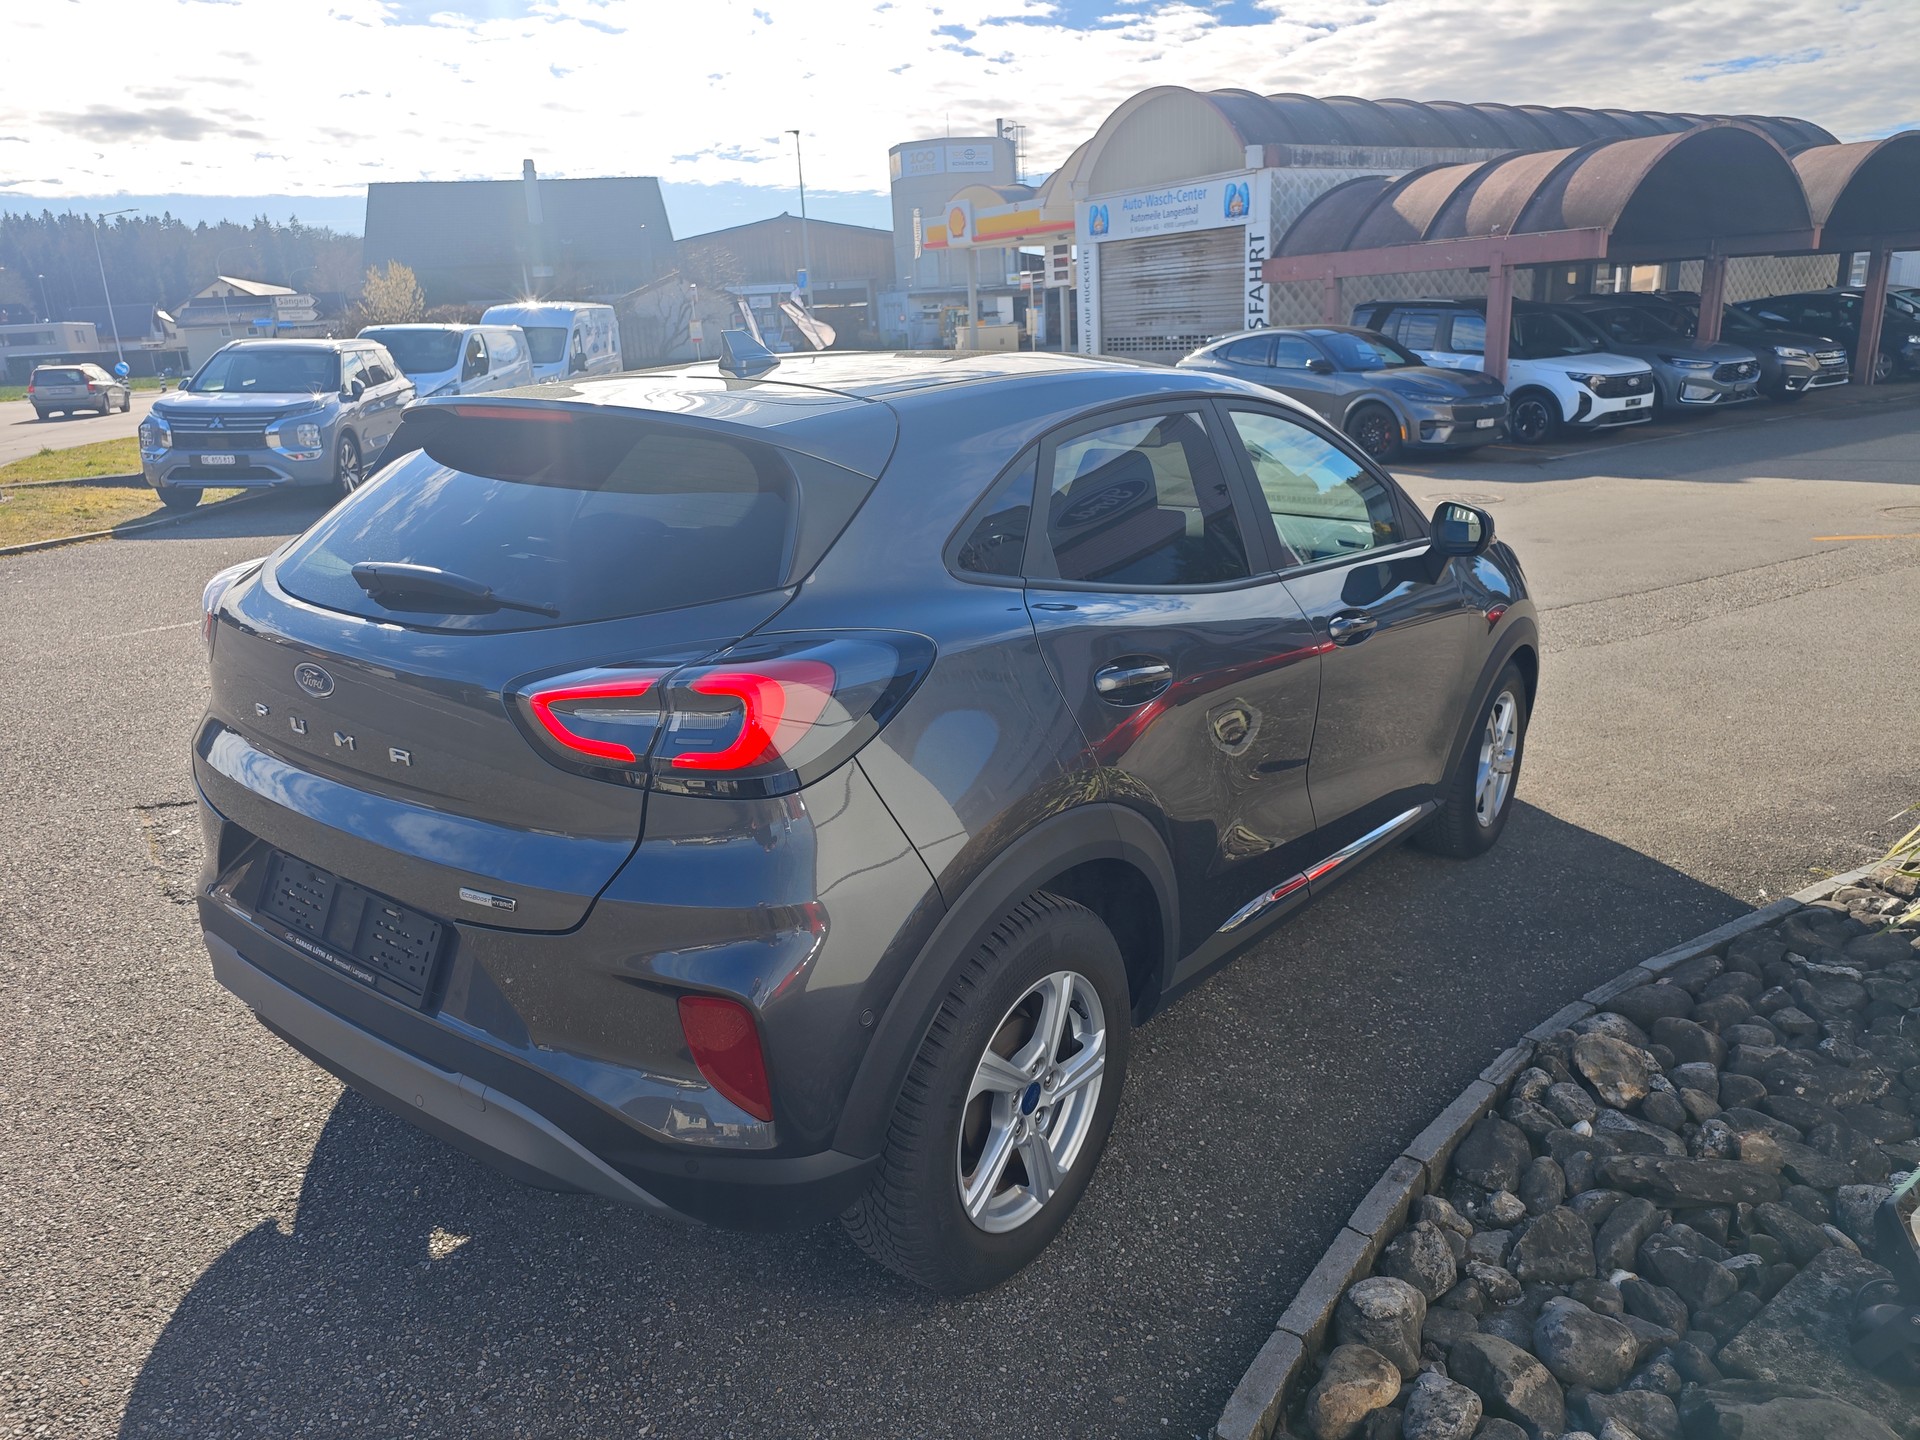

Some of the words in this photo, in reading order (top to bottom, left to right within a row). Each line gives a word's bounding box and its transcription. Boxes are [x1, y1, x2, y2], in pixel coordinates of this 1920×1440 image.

[910, 150, 936, 164] 100
[1122, 188, 1207, 211] Auto-Wasch-Center
[1130, 211, 1161, 223] Automeile
[1162, 204, 1199, 220] Langenthal
[278, 297, 310, 308] Sängeli
[1084, 308, 1092, 327] AUF
[302, 668, 326, 691] Ford
[255, 702, 413, 767] PUMA
[295, 937, 313, 952] GARAGE
[312, 946, 326, 959] LÜTHI
